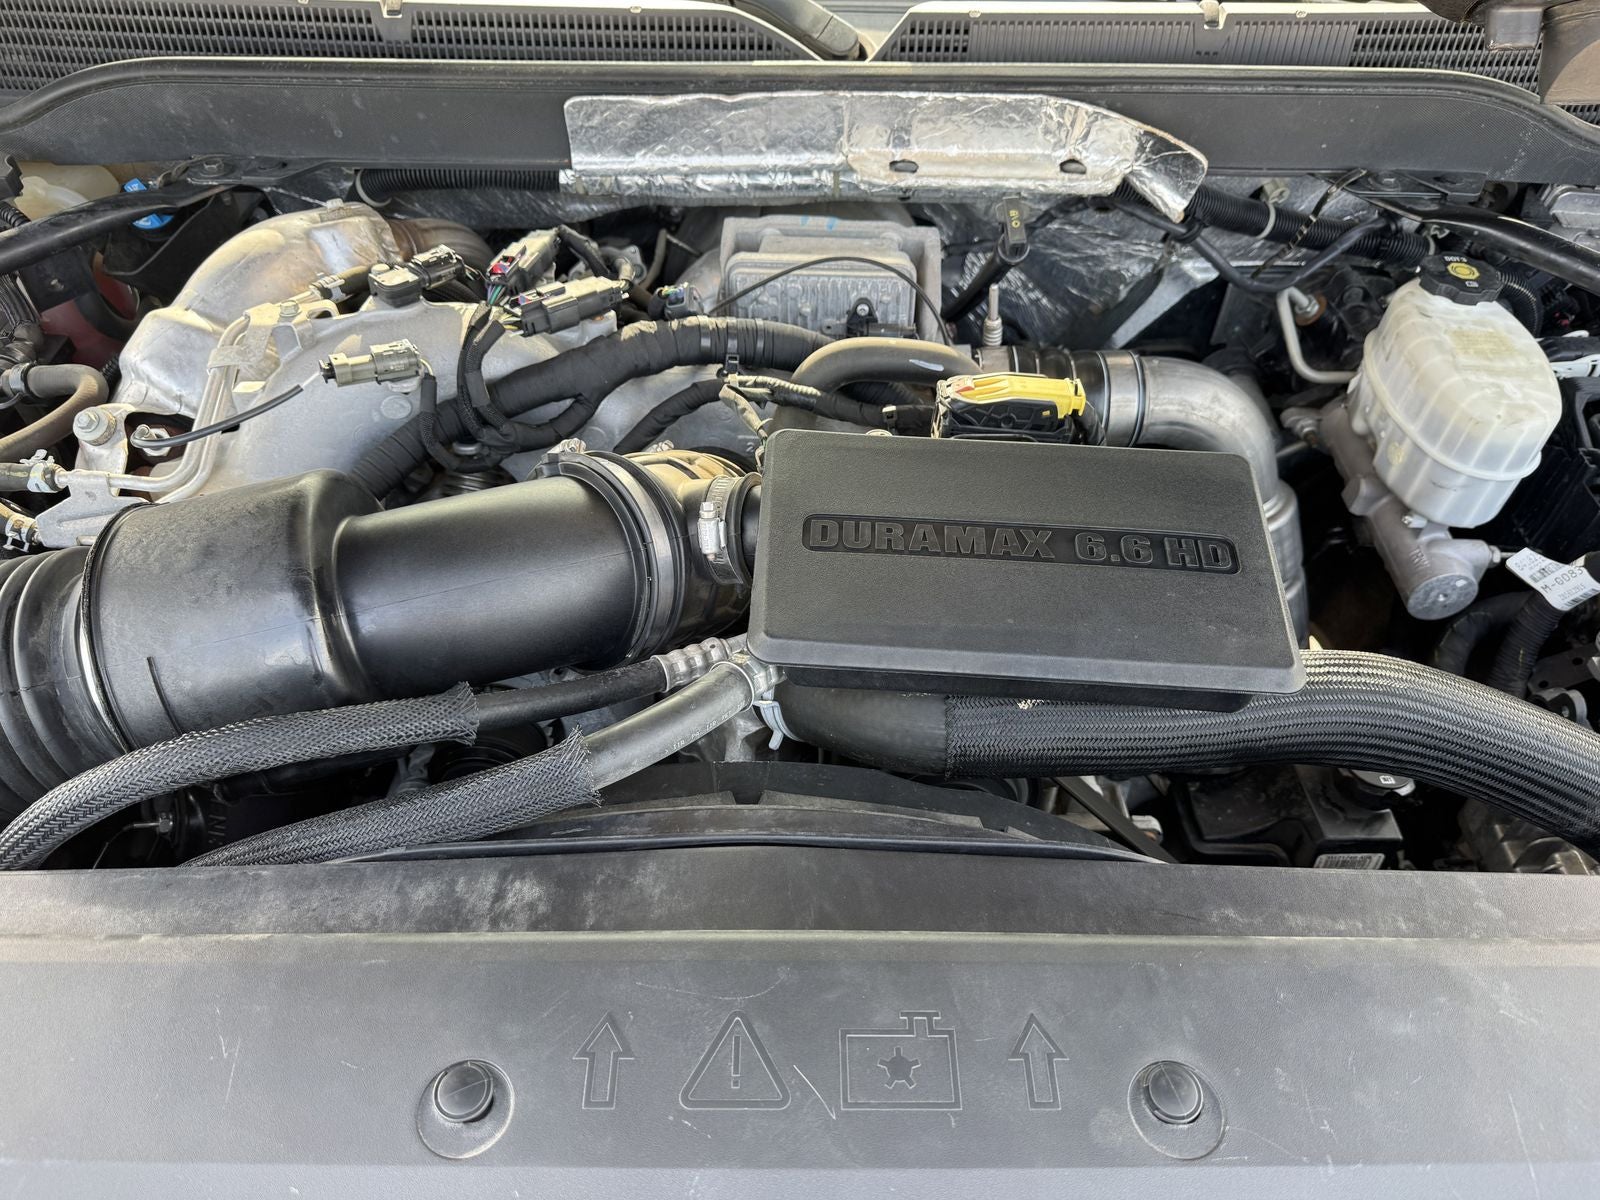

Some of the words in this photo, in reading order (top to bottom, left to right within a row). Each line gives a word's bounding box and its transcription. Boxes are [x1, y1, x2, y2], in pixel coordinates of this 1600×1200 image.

[808, 518, 1056, 559] DURAMAX
[1074, 531, 1154, 565] 6.6
[1163, 536, 1233, 570] HD
